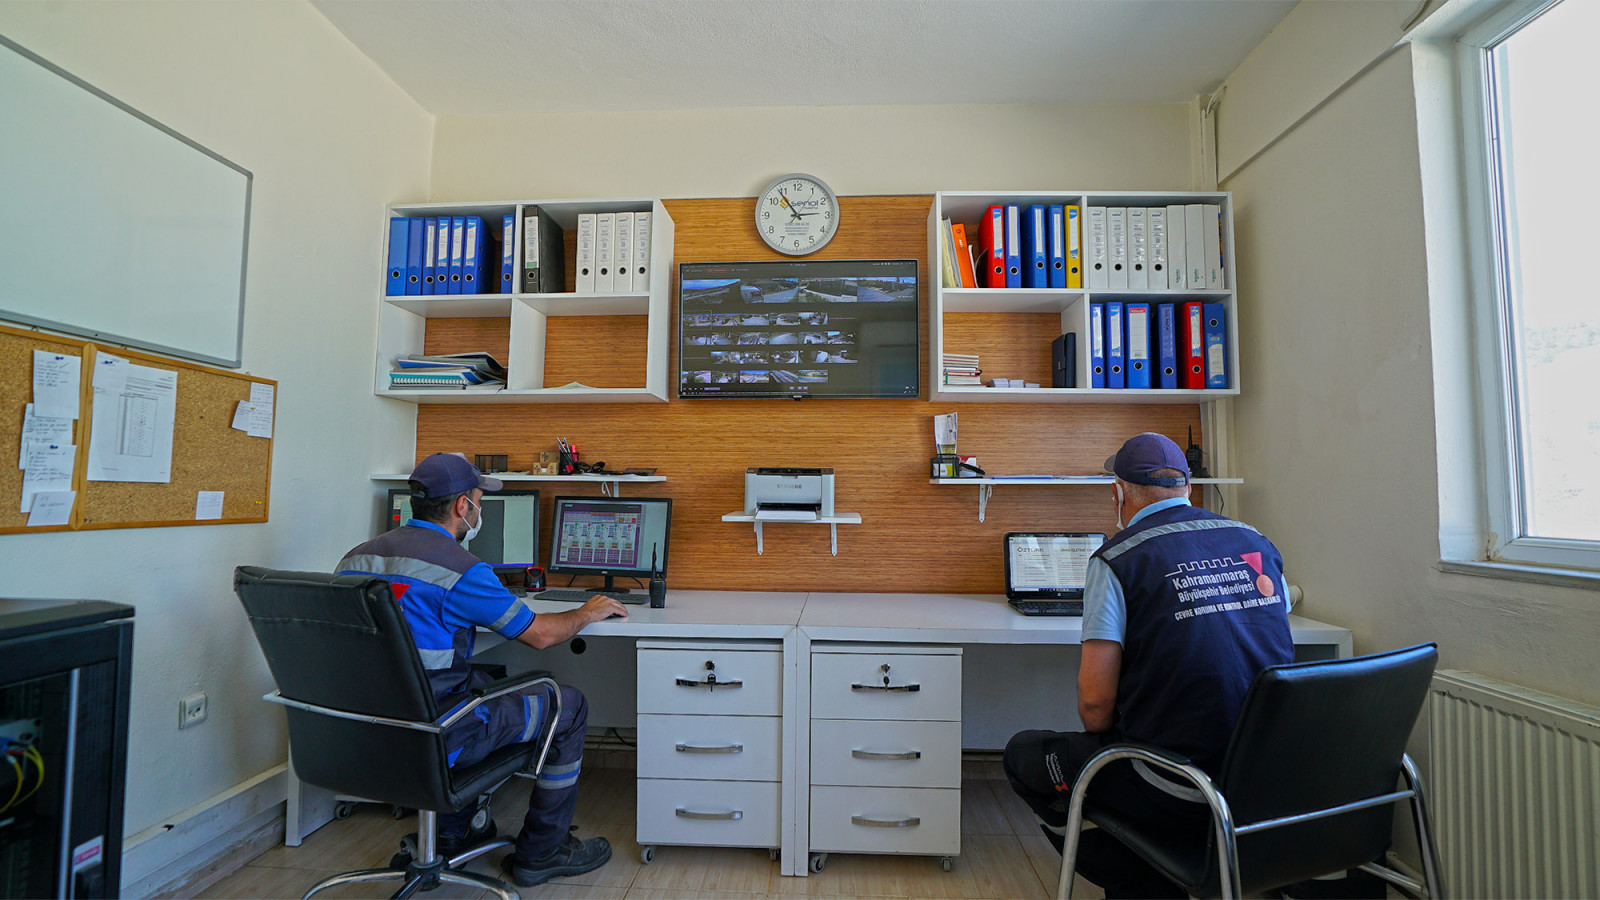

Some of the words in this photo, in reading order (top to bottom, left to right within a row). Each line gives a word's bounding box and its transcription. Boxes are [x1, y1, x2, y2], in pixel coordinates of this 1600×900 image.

[793, 183, 802, 191] 12
[770, 197, 779, 205] 10
[820, 197, 826, 205] 2
[764, 211, 770, 219] 9
[824, 211, 830, 219] 3
[768, 226, 774, 234] 8
[780, 236, 785, 244] 7
[809, 235, 815, 244] 5
[794, 240, 800, 248] 6
[1172, 569, 1250, 590] Kahramanmaraş
[1178, 586, 1219, 603] Büyükşehir
[1218, 581, 1255, 596] Belediyesi
